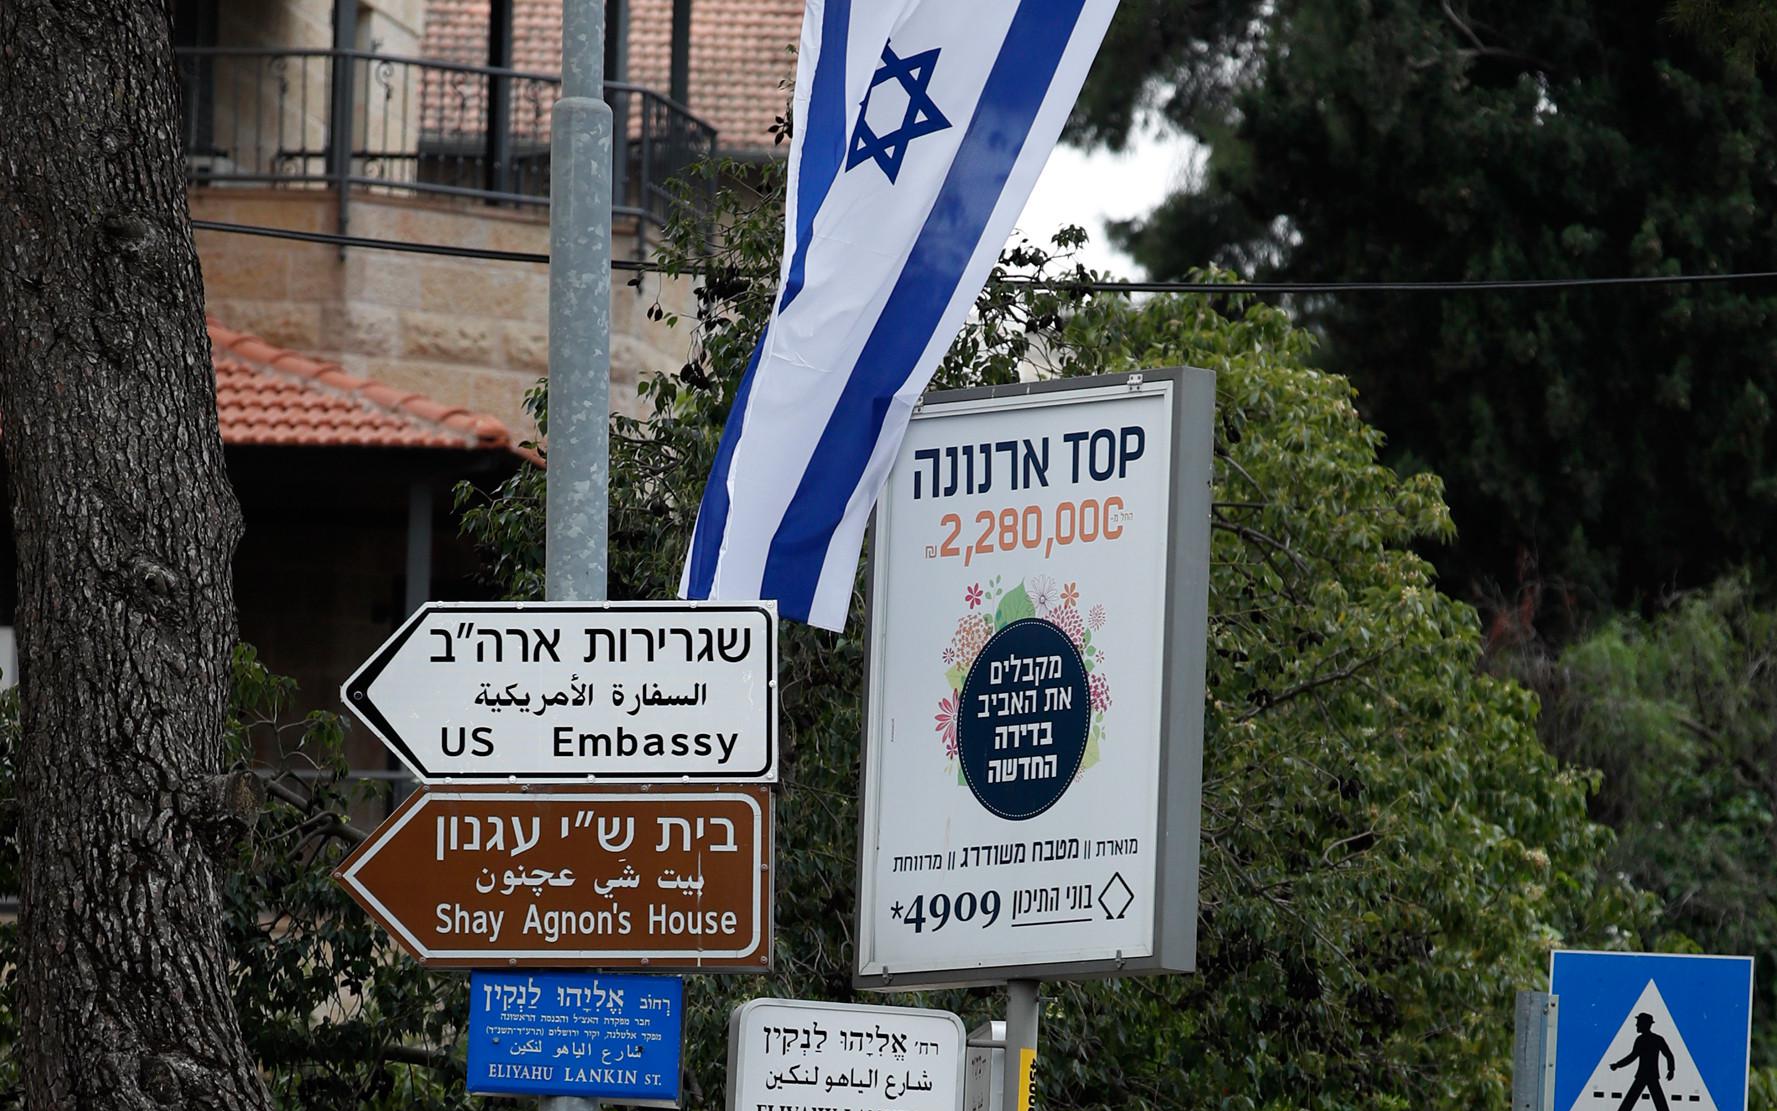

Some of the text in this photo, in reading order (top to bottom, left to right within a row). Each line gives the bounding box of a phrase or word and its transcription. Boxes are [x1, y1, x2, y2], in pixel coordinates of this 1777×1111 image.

[914, 426, 1145, 500] TOP ארנונה
[583, 628, 752, 664] שגרירות
[990, 654, 1063, 687] מקבלים
[474, 673, 707, 717] السفارة الأمريكية
[977, 686, 1073, 719] את האביב
[440, 727, 740, 765] US Embassy
[994, 721, 1053, 750] בדירה
[987, 755, 1058, 784] החדשה
[436, 815, 542, 861] עגנון
[655, 817, 739, 853] בית
[893, 837, 1139, 873] מוארת מטבח משודרג מרווחת
[657, 868, 704, 897] بيت
[1066, 884, 1093, 910] בוני
[1012, 888, 1060, 920] התיכון
[435, 902, 737, 943] Shay Agnon's House
[489, 1064, 662, 1086] ELIYAHU LANKIN ST.
[765, 1065, 933, 1100] شارع الياهو لنكين
